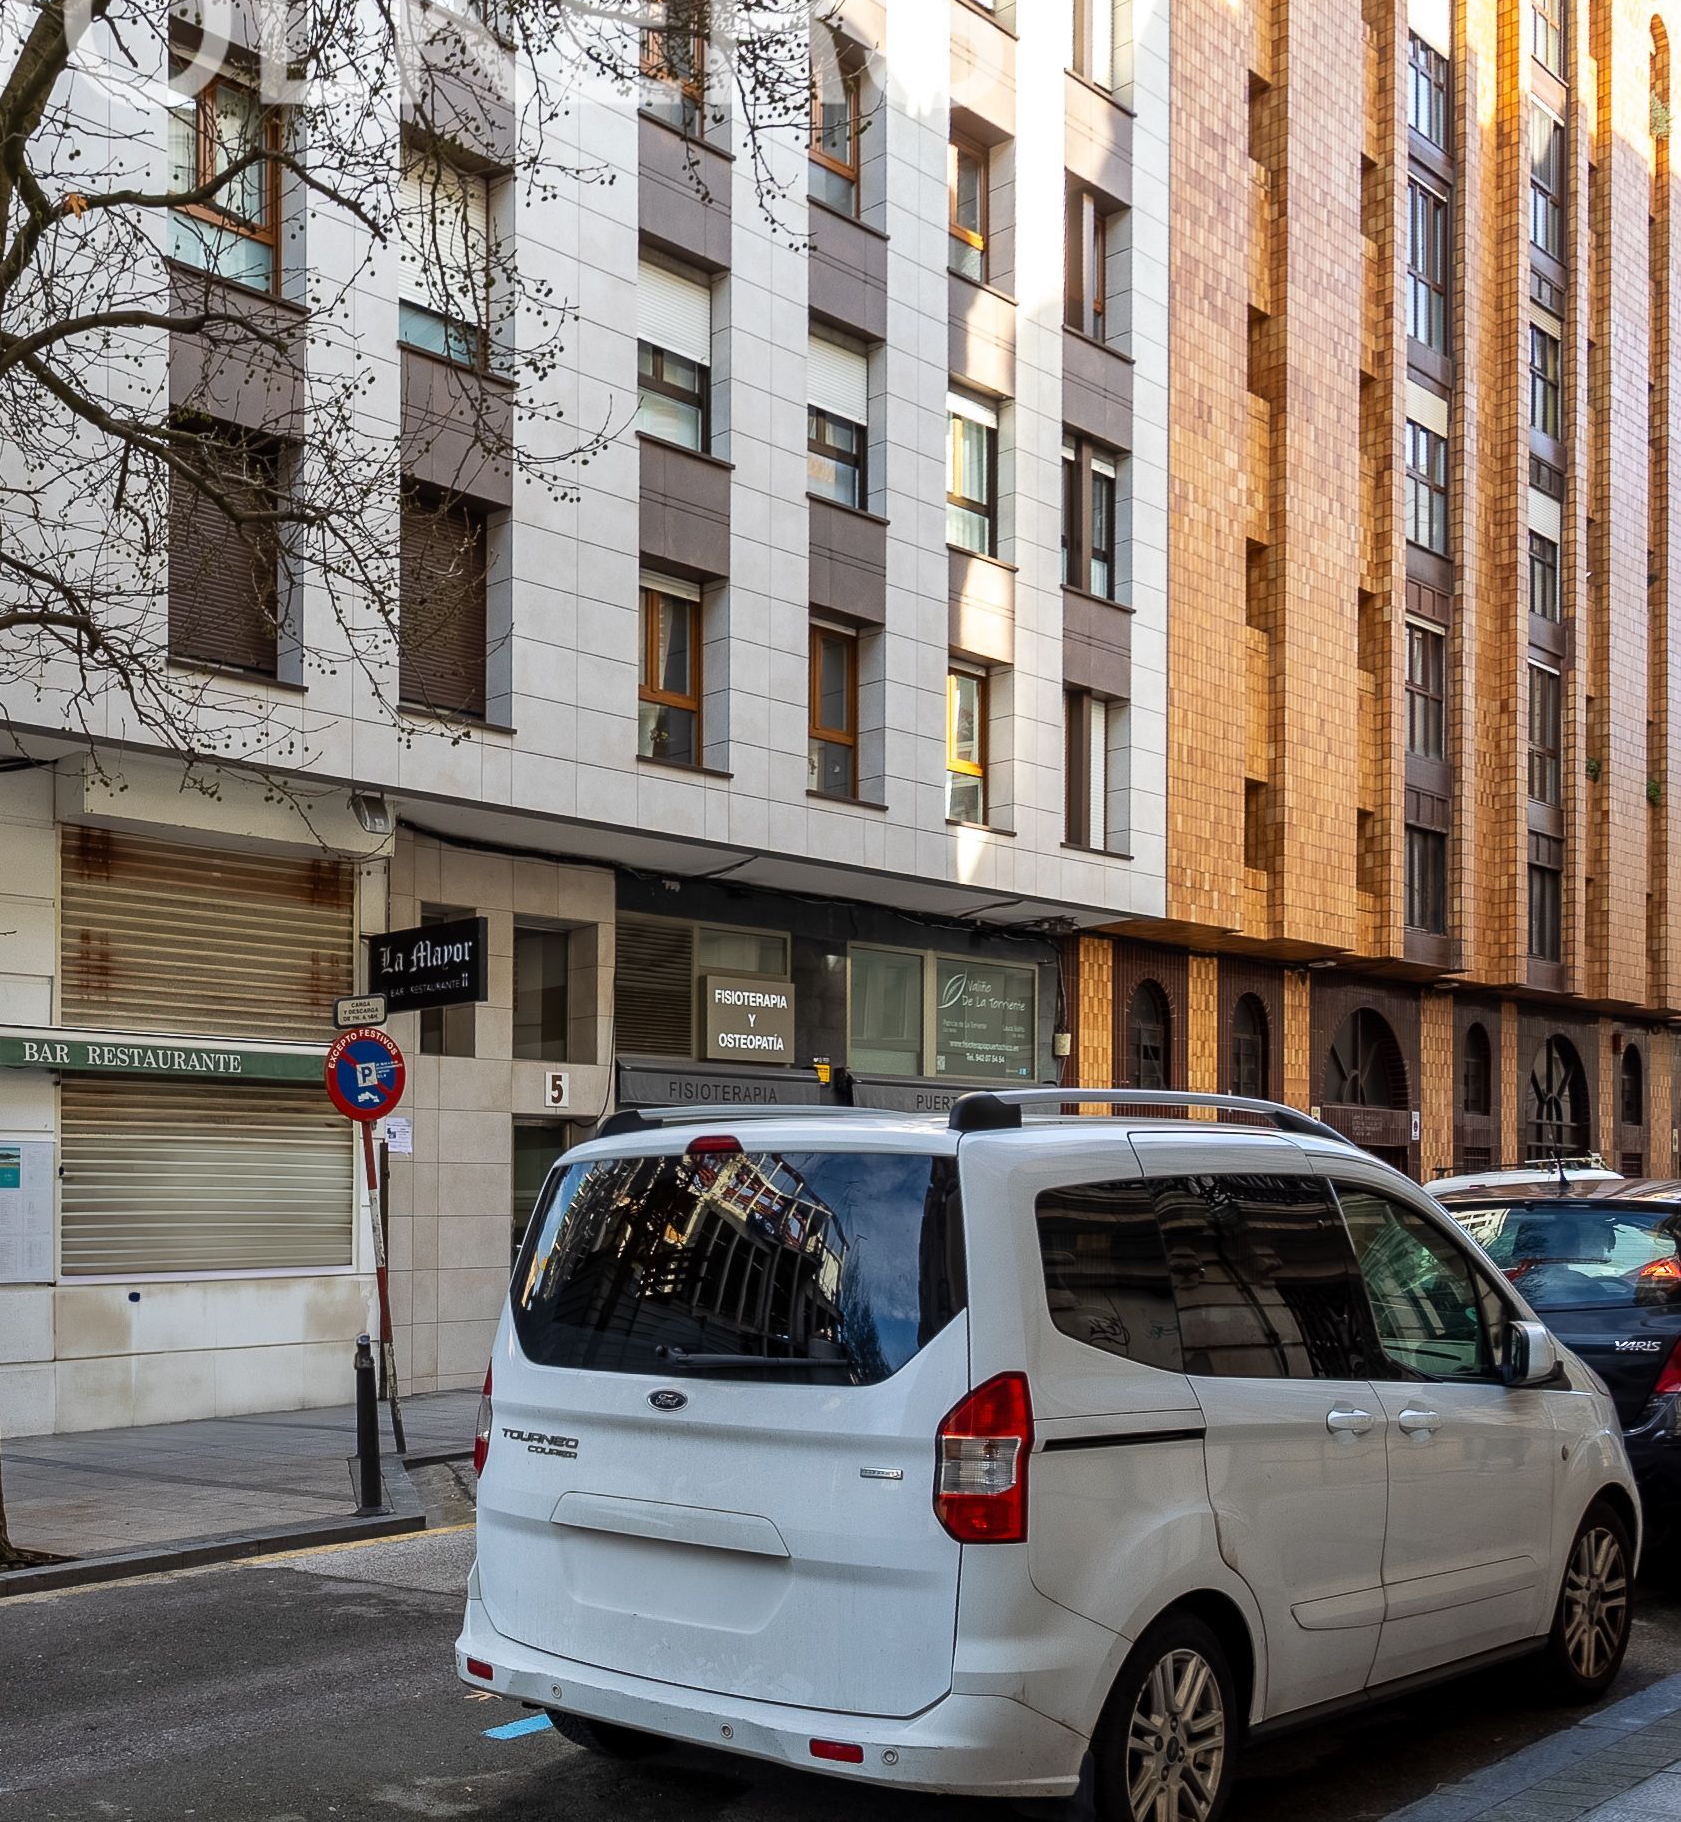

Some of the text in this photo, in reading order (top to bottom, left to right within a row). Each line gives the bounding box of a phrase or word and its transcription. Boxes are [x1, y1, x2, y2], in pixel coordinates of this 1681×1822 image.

[379, 940, 472, 974] La Mayor
[410, 979, 460, 994] RESTAURANTE
[715, 989, 787, 1009] FISIOTERAPIA
[962, 995, 1026, 1011] De La Torriente
[748, 1014, 756, 1027] Y
[328, 1032, 358, 1069] EXCEPTO
[359, 1029, 398, 1055] FESTIVOS
[719, 1033, 784, 1051] OSTEOPATÍA
[23, 1042, 241, 1073] BAR RESTAURANTE
[361, 1066, 372, 1084] P
[551, 1074, 564, 1104] 5
[669, 1081, 777, 1104] FISIOTERAPIA
[1614, 1340, 1662, 1351] YARIS
[655, 1393, 679, 1406] Ford
[501, 1428, 580, 1449] TOURNEO
[527, 1445, 578, 1459] COURIER
